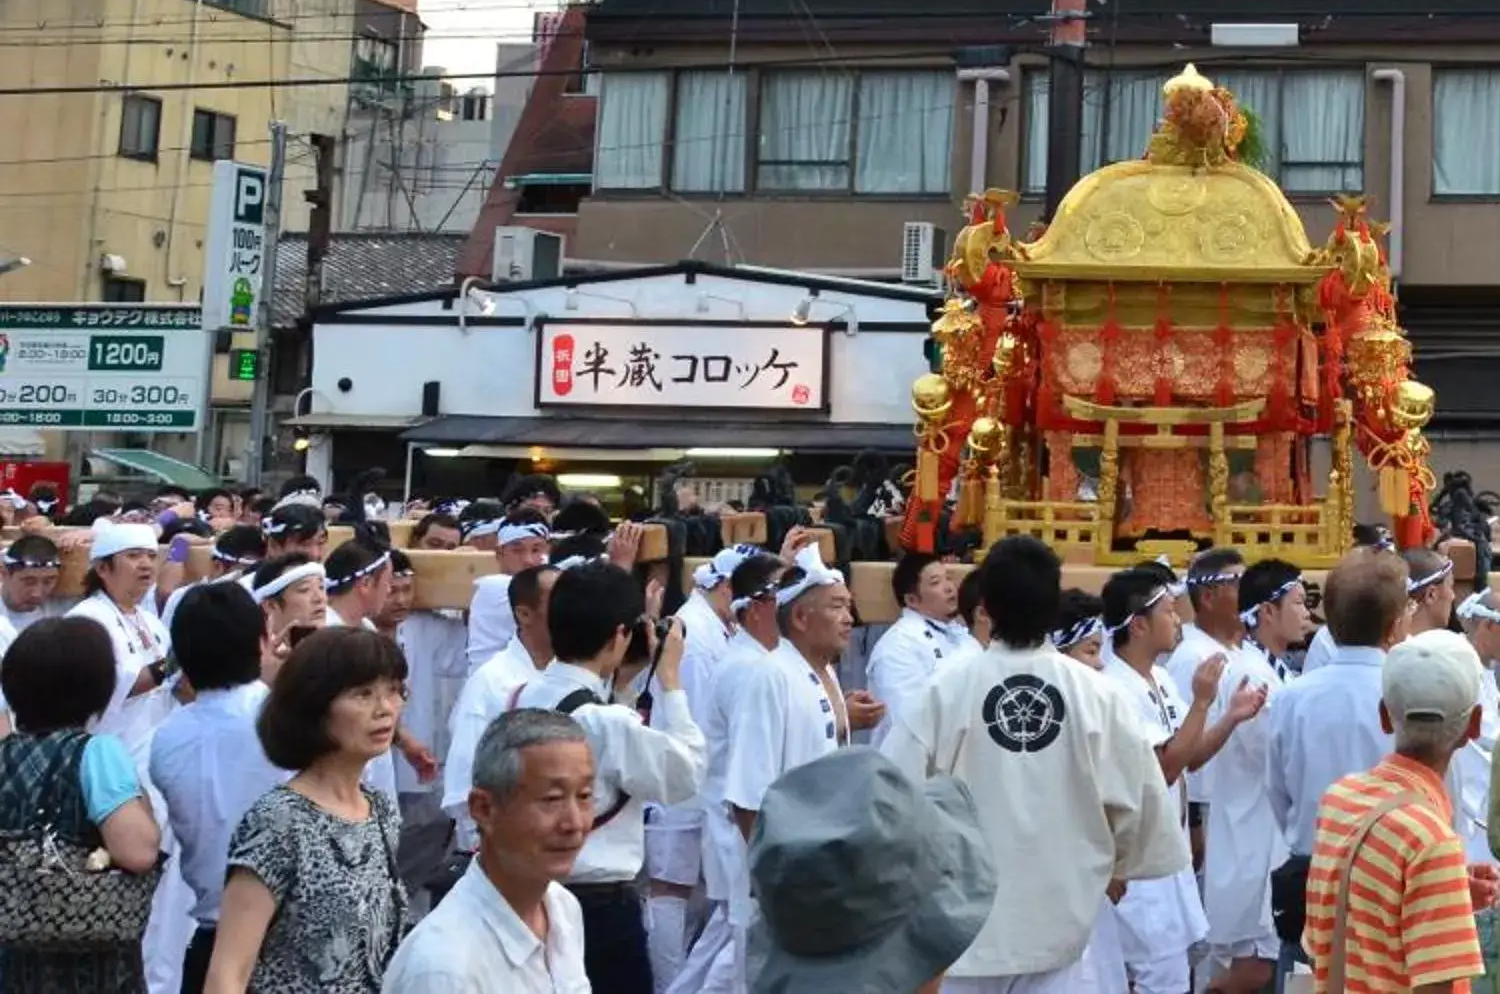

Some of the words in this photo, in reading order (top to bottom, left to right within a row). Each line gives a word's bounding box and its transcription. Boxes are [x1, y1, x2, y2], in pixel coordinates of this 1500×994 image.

[237, 175, 262, 216] P
[232, 227, 261, 250] 100円
[95, 343, 159, 365] 1200円
[576, 342, 798, 392] 半蔵コロッケ
